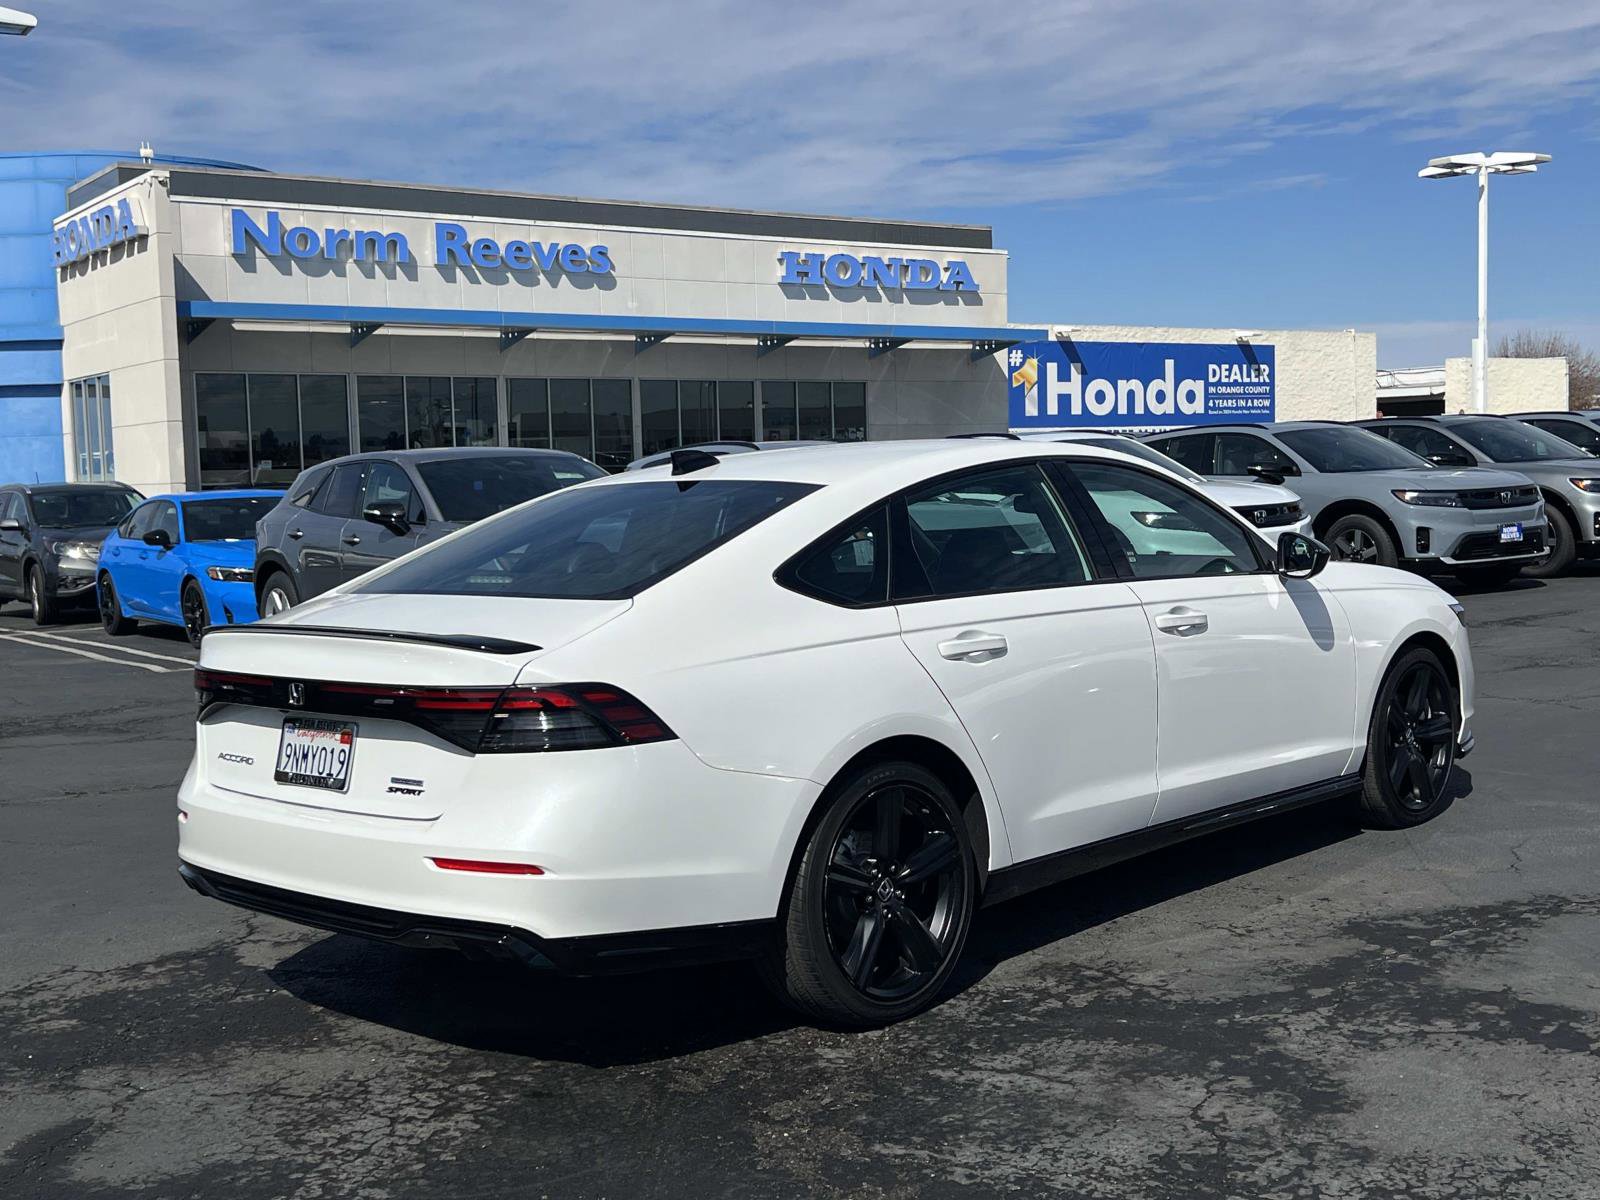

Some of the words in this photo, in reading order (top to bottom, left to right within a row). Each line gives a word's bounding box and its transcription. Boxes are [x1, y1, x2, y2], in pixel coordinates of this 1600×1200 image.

[48, 198, 142, 268] HONDA
[231, 208, 410, 264] Norm
[435, 222, 612, 275] Reeves
[779, 251, 980, 292] HONDA
[1208, 364, 1270, 383] DEALER
[1046, 359, 1205, 416] Honda
[1208, 386, 1216, 394] IN
[1217, 386, 1244, 394] ORANGE
[1244, 386, 1270, 394] COUNTY
[1208, 399, 1214, 408] 4
[1214, 399, 1237, 408] YEARS
[1238, 399, 1246, 408] IN
[1246, 399, 1253, 408] A
[1253, 399, 1271, 408] ROW
[217, 752, 254, 766] ACCORD
[282, 742, 347, 778] 9NMY019
[385, 786, 426, 797] SPORT
